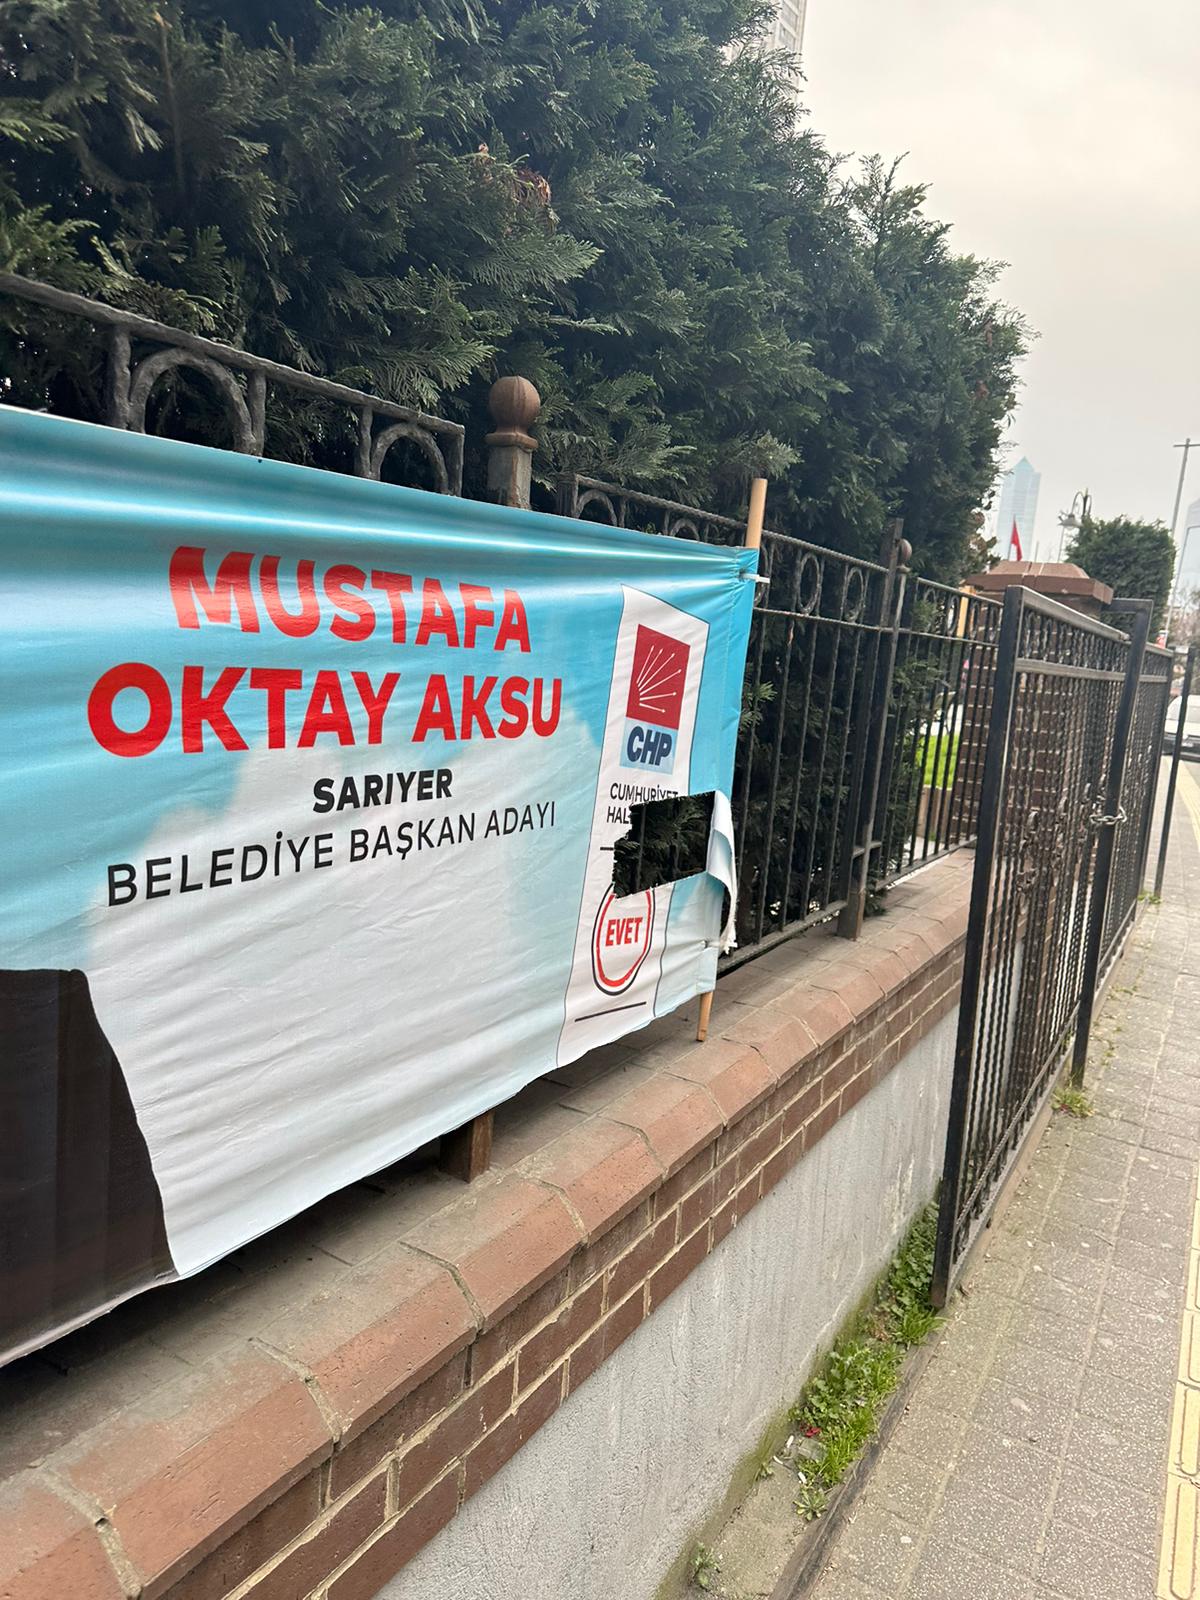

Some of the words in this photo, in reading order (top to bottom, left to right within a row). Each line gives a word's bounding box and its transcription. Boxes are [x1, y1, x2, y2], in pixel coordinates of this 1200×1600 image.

[168, 546, 531, 653] MUSTAFA
[87, 662, 401, 757] OKTAY
[411, 674, 562, 742] AKSU
[627, 726, 672, 766] CHP
[312, 768, 453, 813] SARIYER
[606, 806, 632, 824] HAL
[107, 831, 334, 906] BELEDİYE
[349, 812, 476, 861] BAŞKAN
[485, 801, 556, 839] ADAYI
[605, 917, 643, 947] EVET
